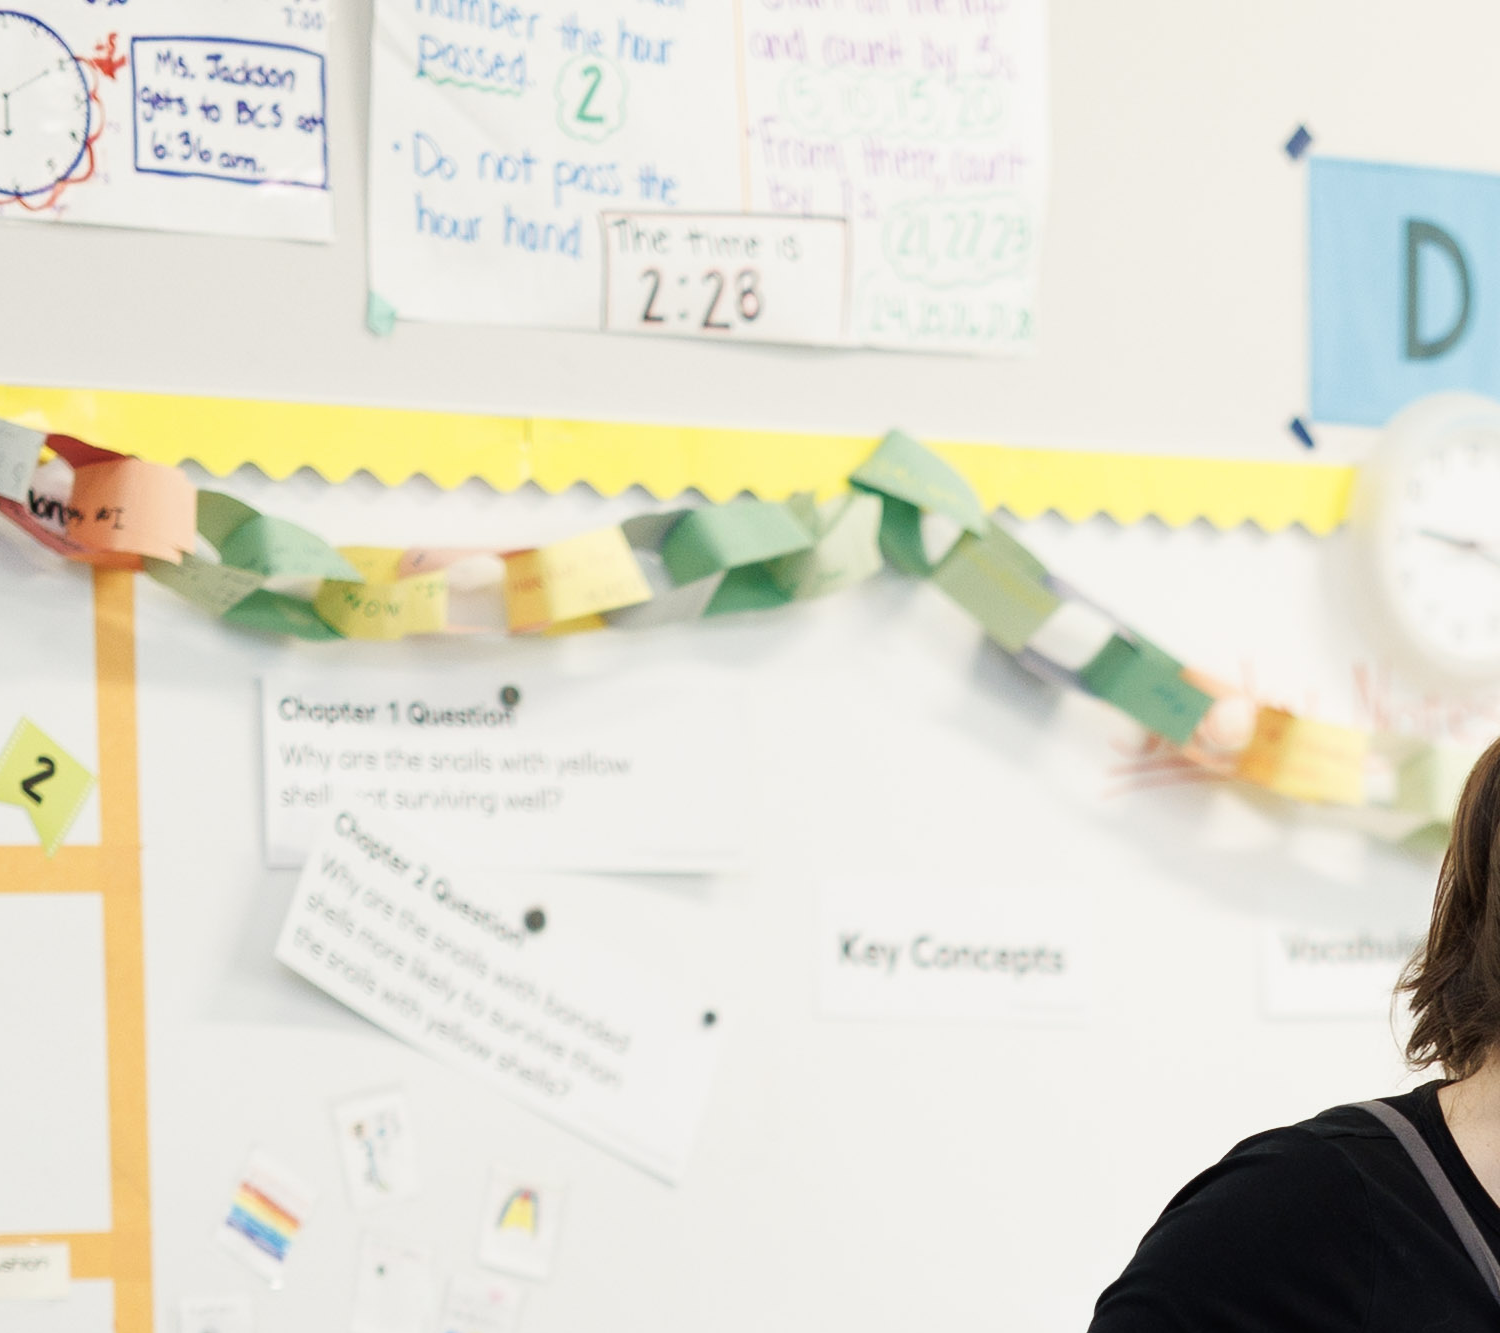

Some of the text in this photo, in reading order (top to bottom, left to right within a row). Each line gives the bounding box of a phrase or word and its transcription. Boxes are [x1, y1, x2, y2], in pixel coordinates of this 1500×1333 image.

[205, 53, 296, 92] Jackson
[575, 65, 607, 123] 2
[639, 267, 762, 331] 2:28
[1404, 217, 1476, 362] D
[278, 696, 516, 729] Chapter 1 Question
[334, 810, 412, 877] Chapter
[430, 876, 527, 949] Question
[838, 931, 1067, 978] Key Concepts
